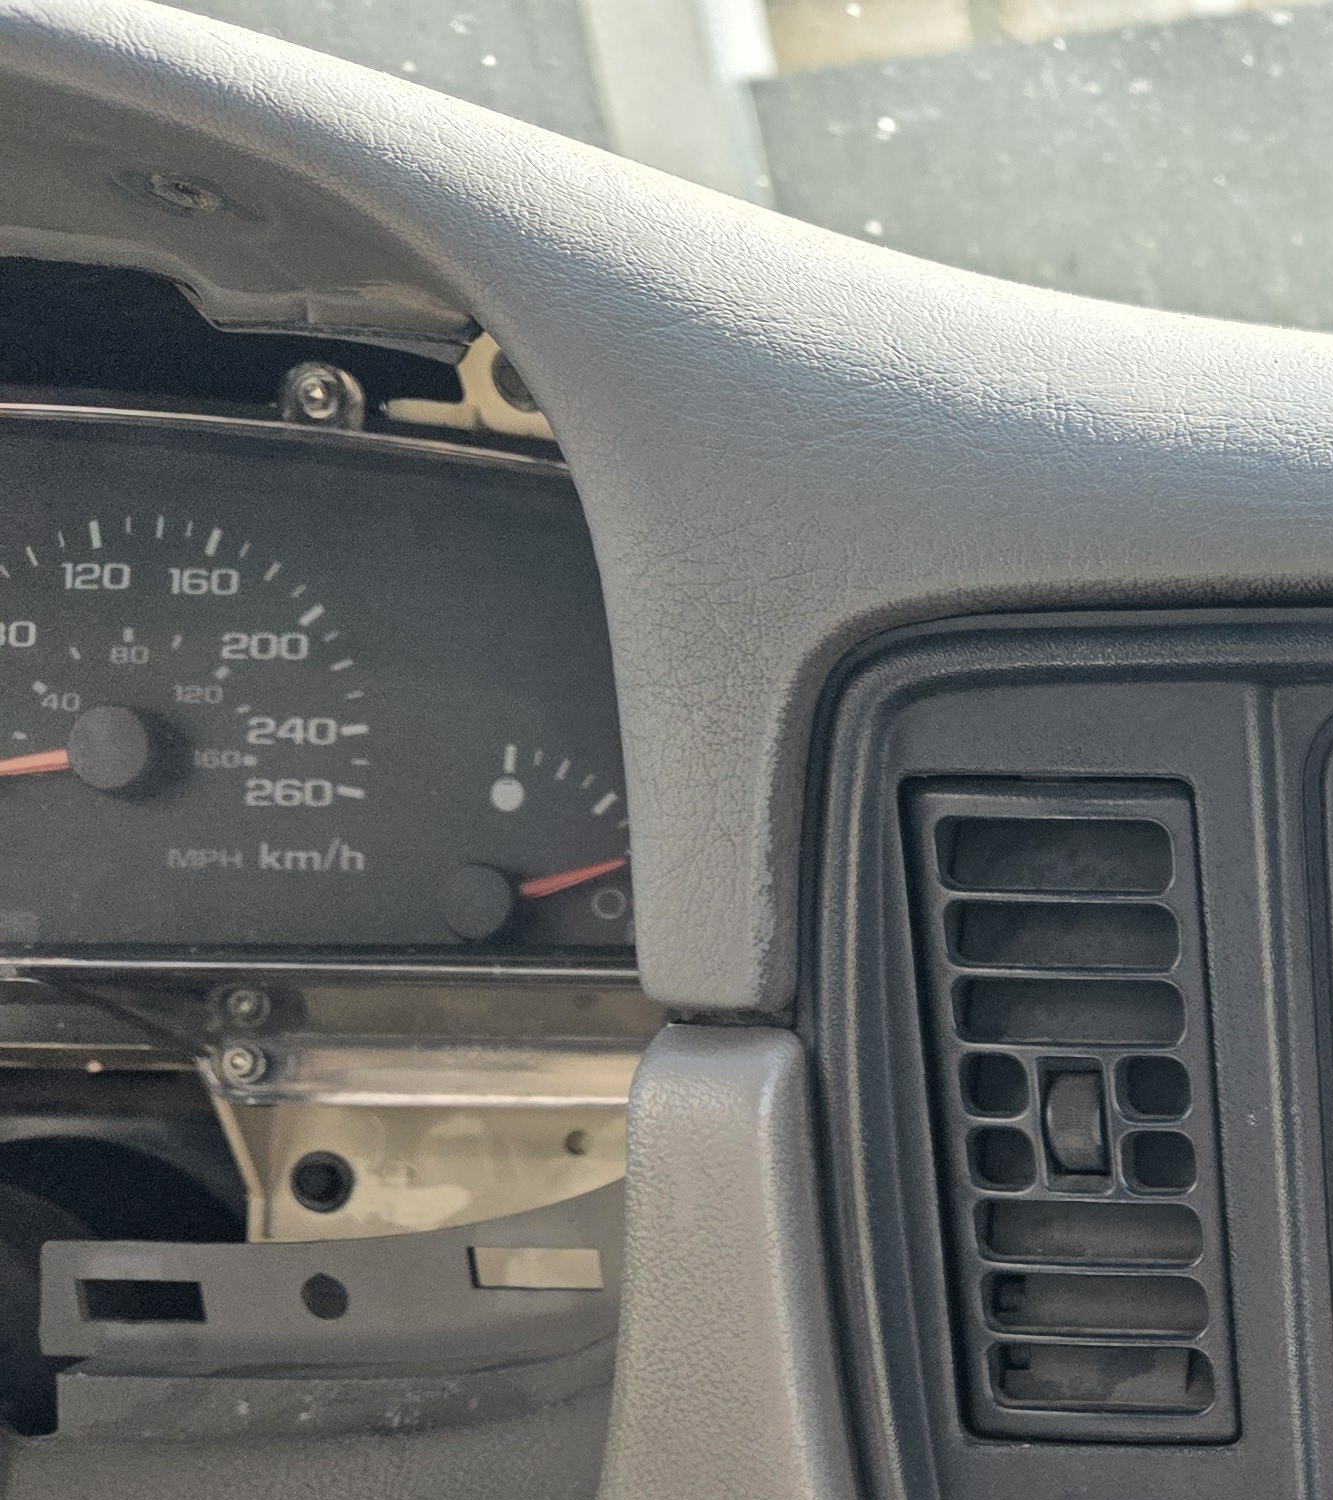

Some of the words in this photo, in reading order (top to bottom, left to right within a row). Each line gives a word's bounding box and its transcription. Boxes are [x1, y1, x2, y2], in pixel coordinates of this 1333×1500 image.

[61, 561, 132, 591] 120
[168, 567, 241, 597] 160
[0, 620, 37, 648] 0
[220, 631, 311, 661] 200
[109, 645, 150, 665] 80
[41, 692, 81, 713] 40
[172, 684, 224, 705] 120
[245, 716, 338, 747] 240
[244, 778, 334, 808] 260
[257, 838, 366, 872] km/h
